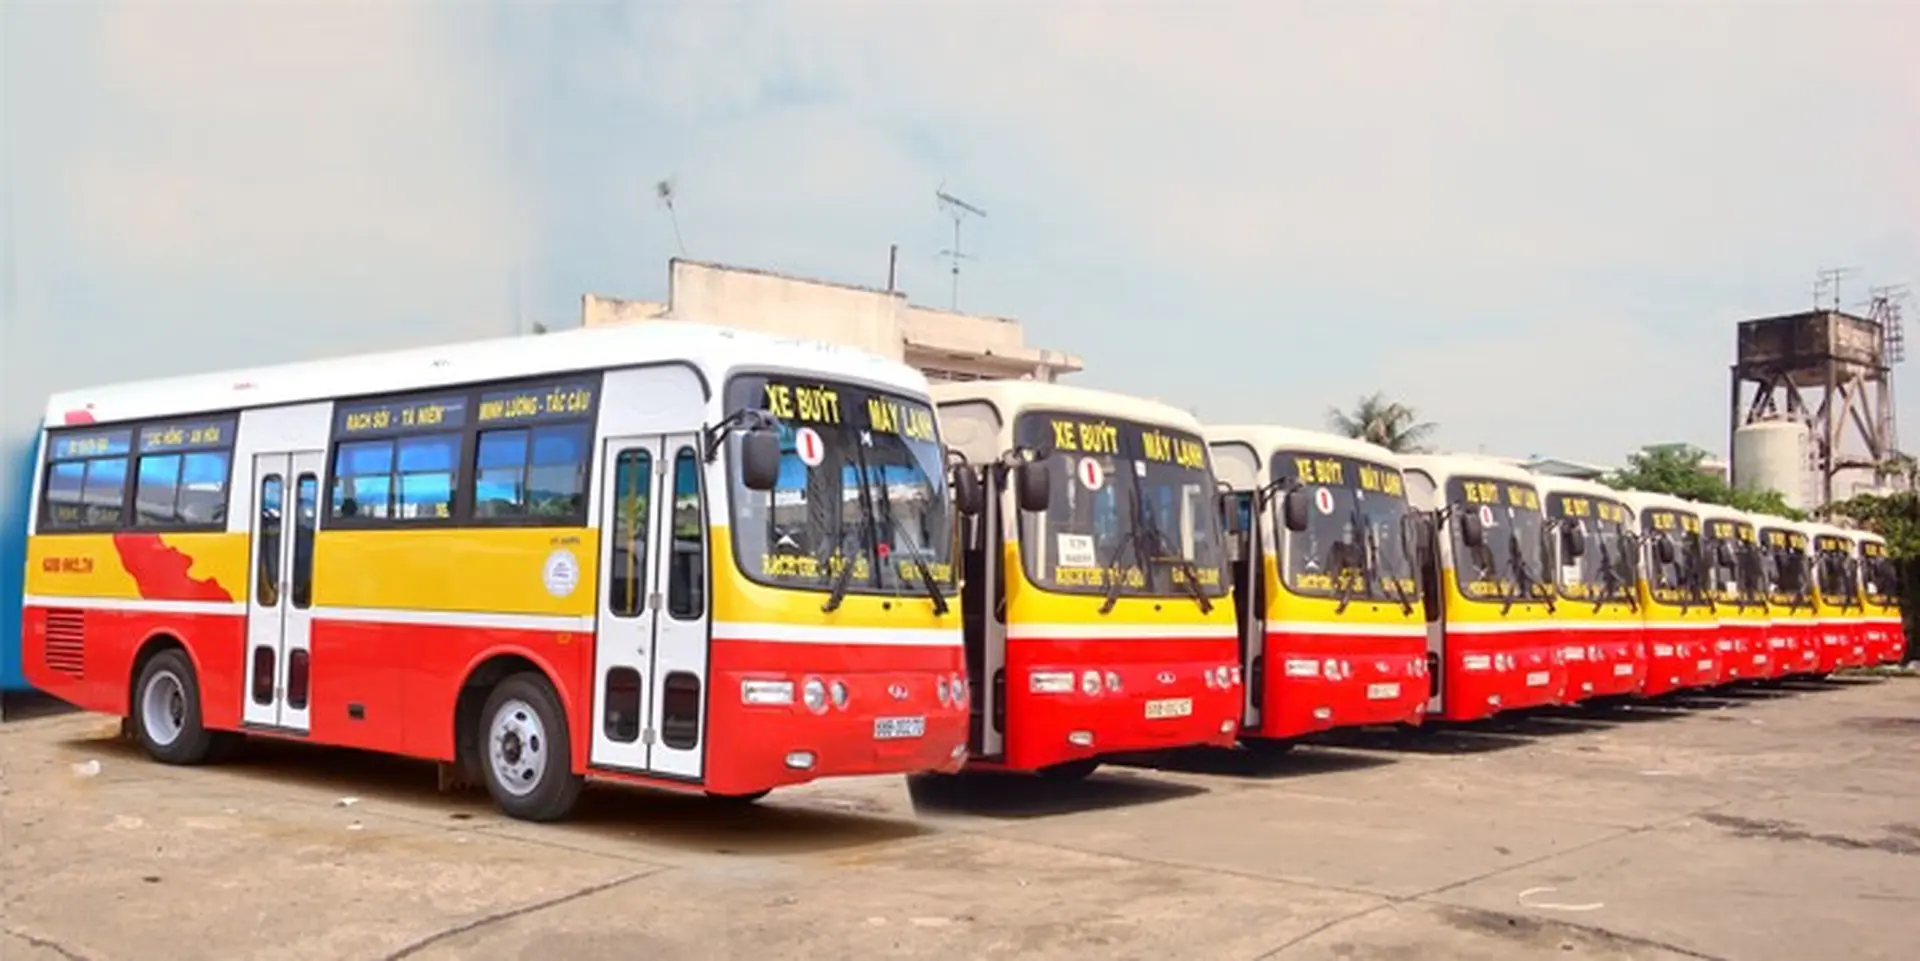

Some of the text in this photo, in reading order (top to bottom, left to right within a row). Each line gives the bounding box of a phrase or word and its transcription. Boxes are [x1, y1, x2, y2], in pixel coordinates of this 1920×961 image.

[765, 385, 794, 418] XE
[796, 385, 840, 424] BUÝT
[868, 396, 900, 434] MÁY
[1052, 420, 1078, 451] XE
[1079, 420, 1119, 455] BUÝT
[1142, 429, 1172, 462] MÁY
[1294, 457, 1315, 482] XE
